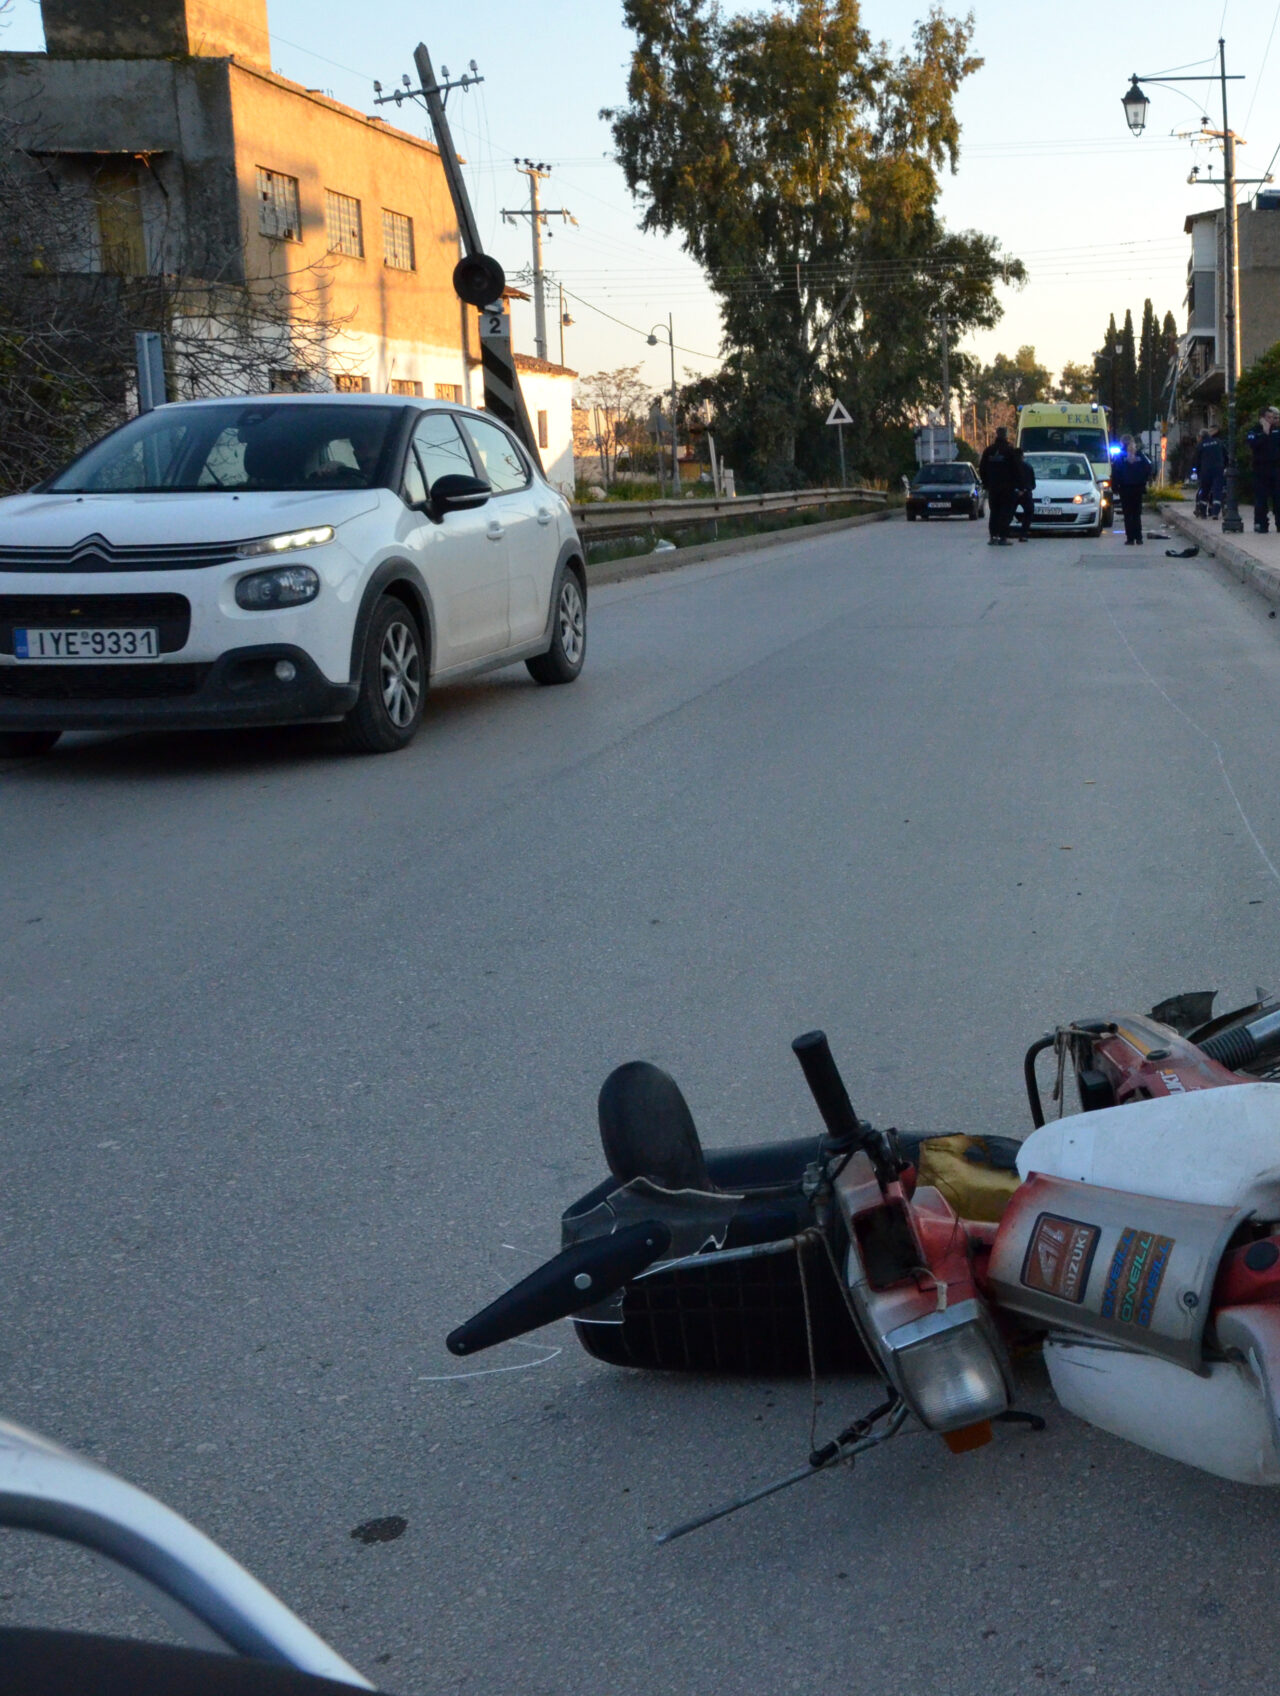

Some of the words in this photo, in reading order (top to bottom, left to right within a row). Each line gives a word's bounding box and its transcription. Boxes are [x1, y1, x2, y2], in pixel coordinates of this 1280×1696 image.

[489, 317, 502, 334] 2
[38, 631, 153, 655] IYE-9331
[1064, 1229, 1090, 1297] SUZUKI
